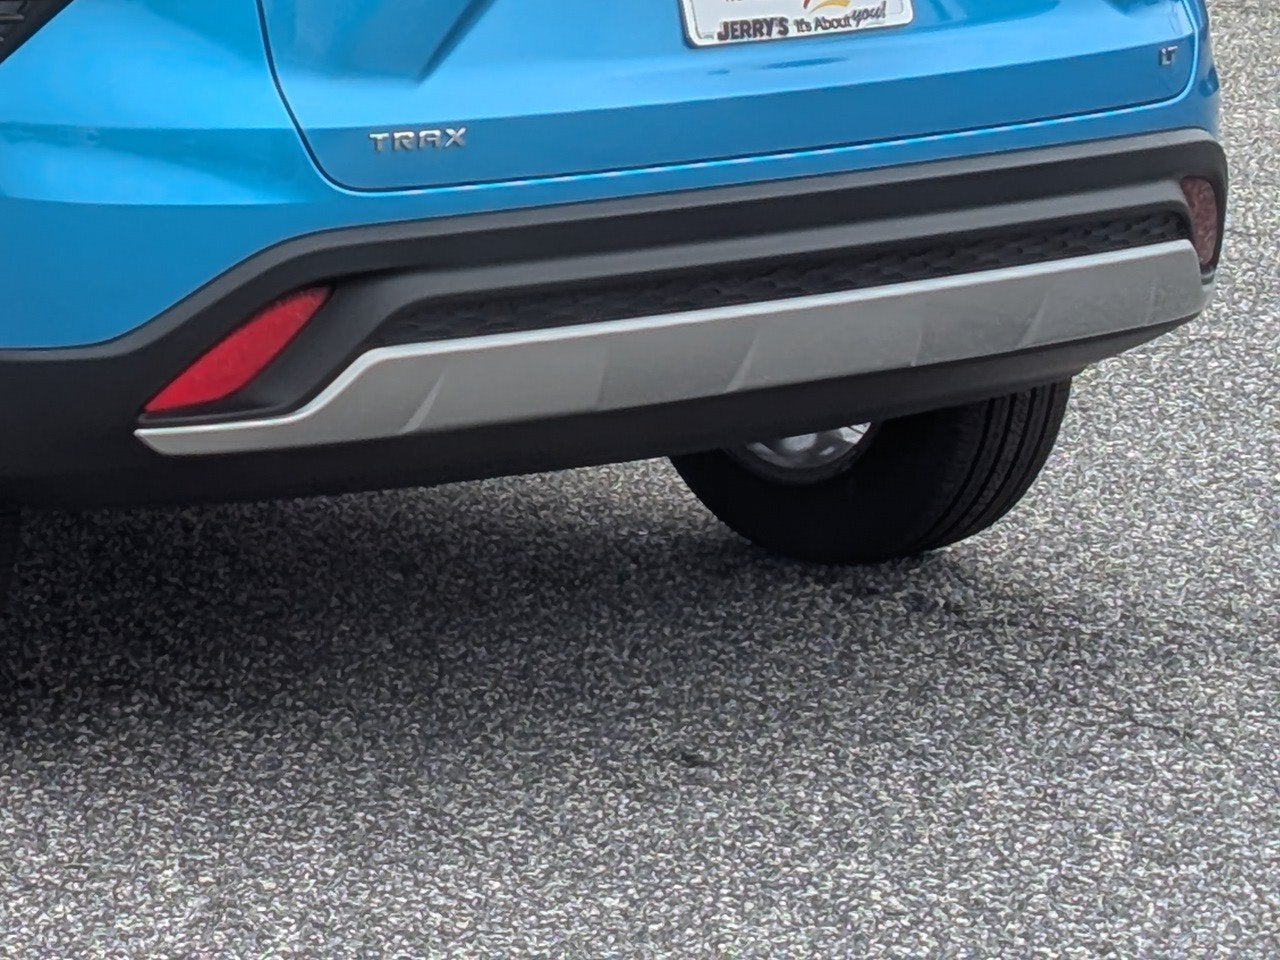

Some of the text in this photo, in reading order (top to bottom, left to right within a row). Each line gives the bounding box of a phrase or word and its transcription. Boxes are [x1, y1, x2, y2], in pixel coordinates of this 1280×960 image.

[717, 0, 887, 41] JERRY'S It's About you!
[1158, 45, 1178, 66] LT
[369, 127, 467, 153] TRAX
